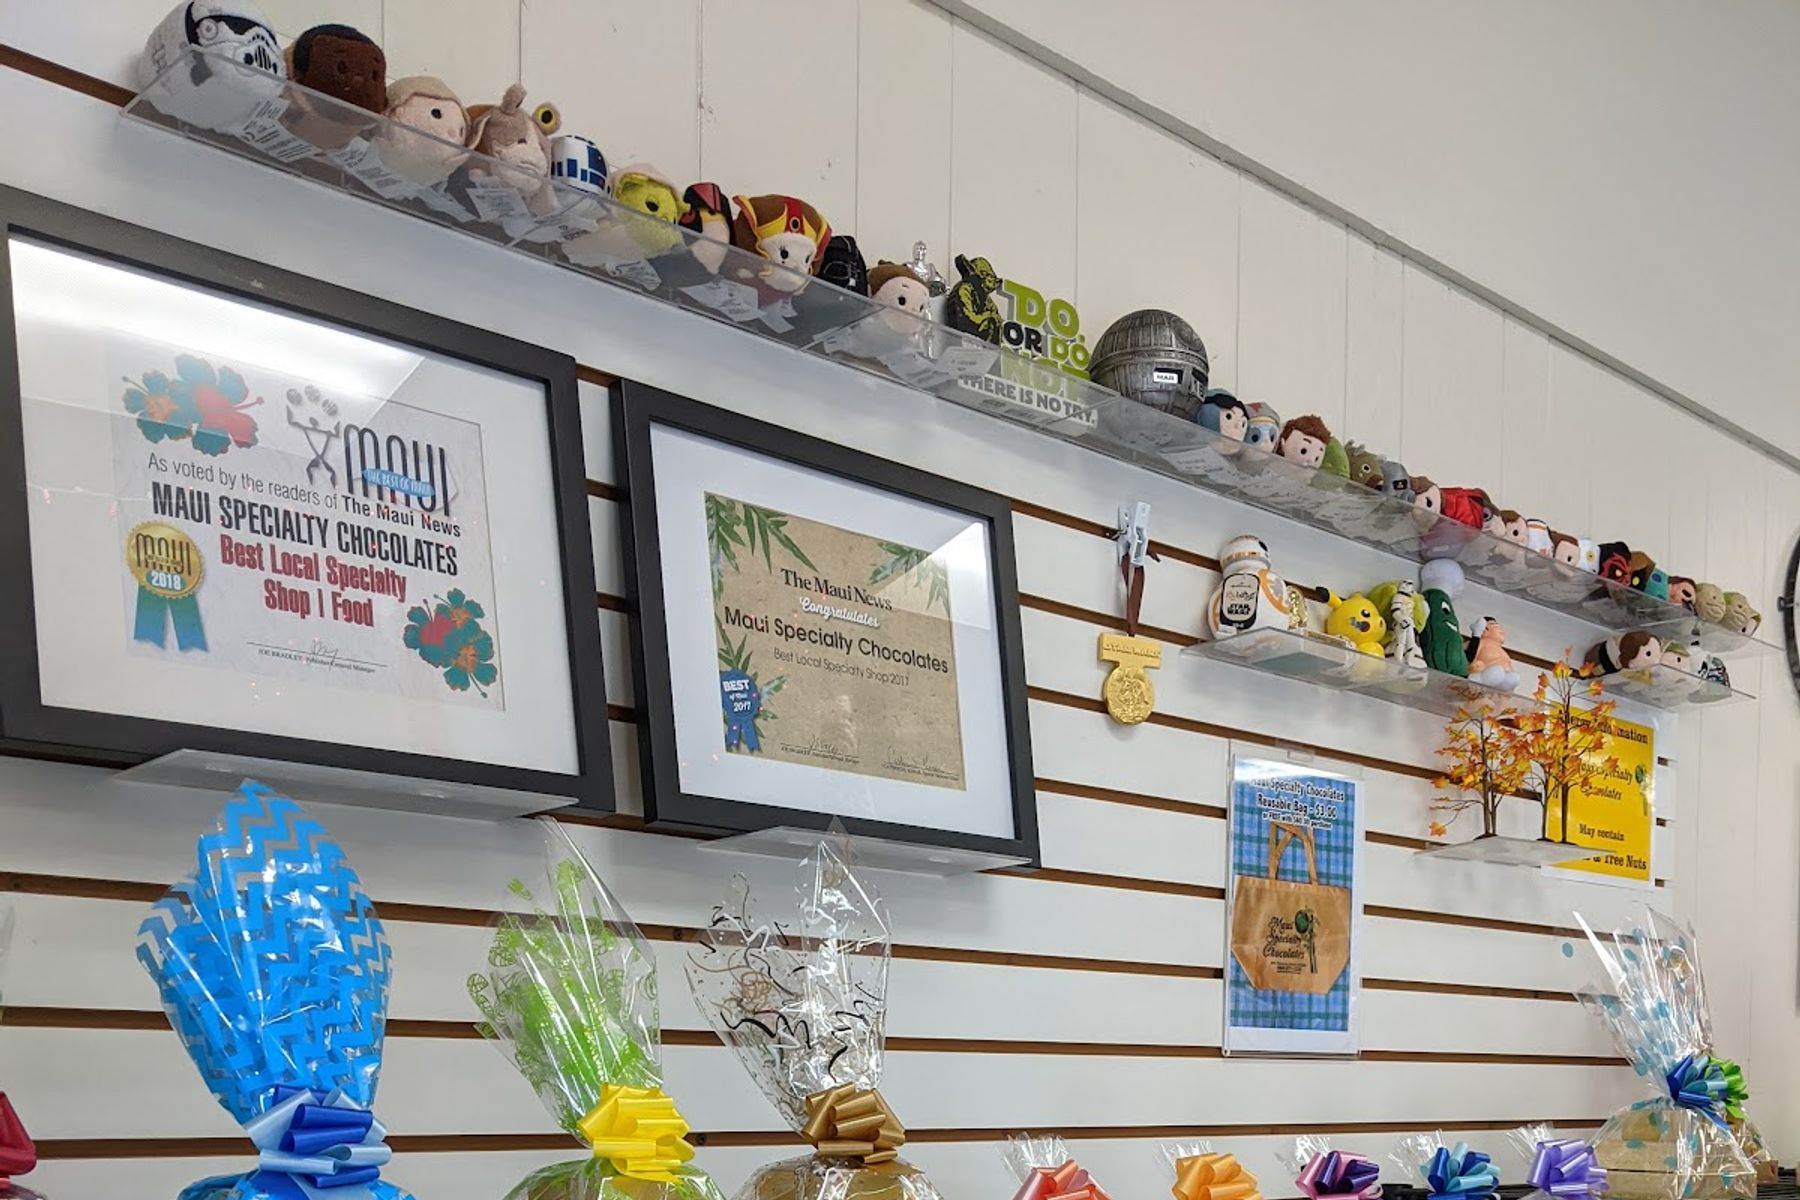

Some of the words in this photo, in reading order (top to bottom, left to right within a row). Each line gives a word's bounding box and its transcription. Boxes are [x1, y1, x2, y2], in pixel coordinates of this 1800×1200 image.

[1003, 321, 1042, 353] OR
[1050, 336, 1090, 370] DO
[959, 375, 1016, 401] THERE
[1020, 387, 1034, 405] IS
[1037, 391, 1063, 413] NO
[149, 452, 168, 471] As
[173, 460, 214, 483] voted
[220, 464, 236, 490] by
[242, 473, 264, 493] the
[268, 481, 320, 506] readers
[325, 490, 339, 509] of
[341, 495, 371, 517] The
[377, 504, 414, 527] Maui
[422, 513, 461, 537] News
[152, 482, 211, 525] MAUI
[219, 496, 329, 549] SPECIALTY
[338, 524, 458, 577] CHOCOLATES
[151, 570, 181, 591] 2018
[220, 534, 264, 571] Best
[270, 545, 320, 582] Local
[326, 555, 407, 603] Specialty
[263, 580, 311, 620] Shop
[331, 590, 374, 628] Food
[780, 568, 812, 591] The
[814, 576, 851, 601] Maui
[853, 586, 892, 611] News
[800, 596, 880, 628] Congratulates
[725, 606, 769, 634] Maui
[775, 619, 853, 656] Specialty
[859, 638, 949, 674] Chocolates
[774, 648, 793, 664] Best
[796, 652, 822, 669] Local
[823, 657, 864, 680] Specialty
[865, 665, 889, 685] Shop
[723, 679, 749, 692] BEST
[733, 701, 751, 712] 2017
[1257, 793, 1291, 810] Reusable
[1293, 799, 1308, 817] Bag
[1306, 783, 1344, 801] Chocolates
[1579, 823, 1596, 838] May
[1597, 829, 1624, 841] contain
[1626, 854, 1647, 870] Nuts
